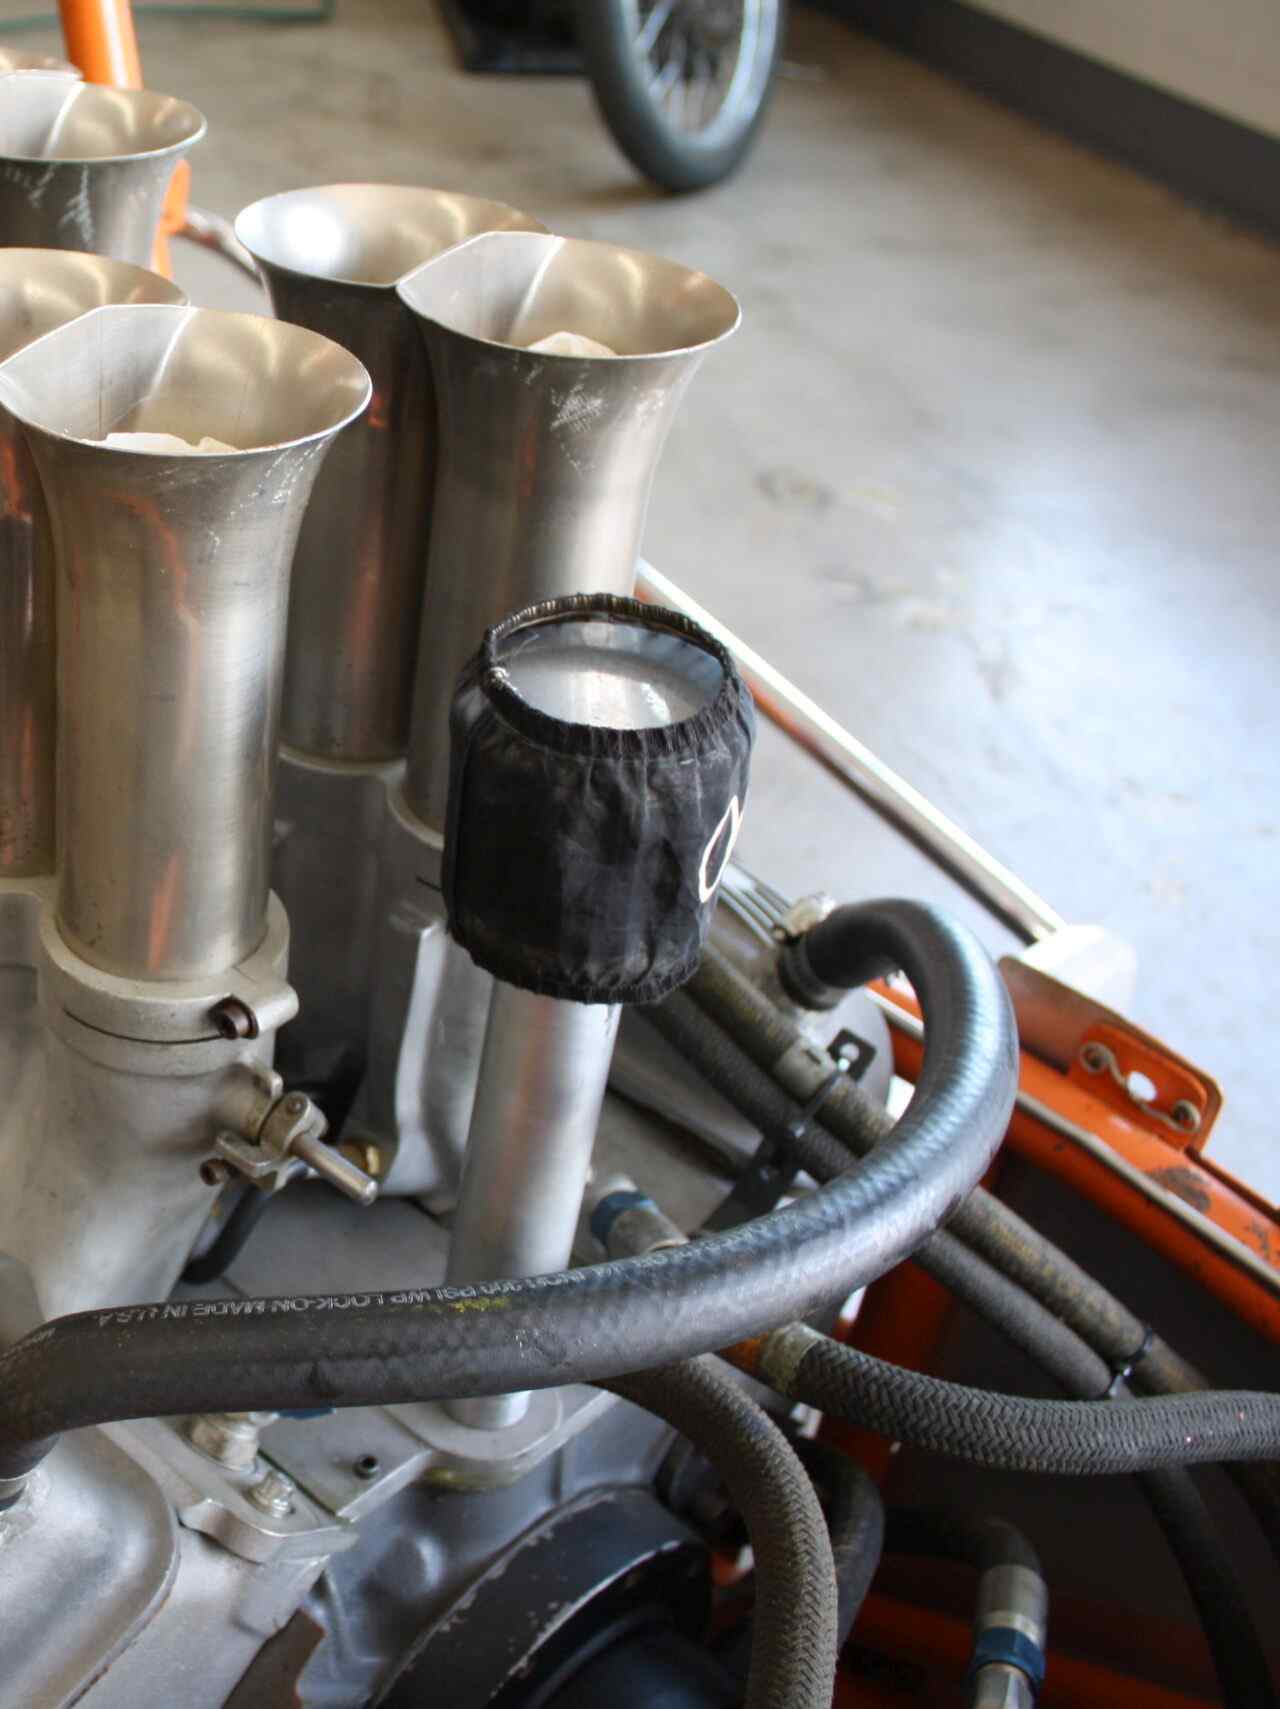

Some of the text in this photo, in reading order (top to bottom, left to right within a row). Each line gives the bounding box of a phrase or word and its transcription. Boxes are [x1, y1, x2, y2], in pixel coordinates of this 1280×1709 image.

[436, 1287, 477, 1300] PSI
[163, 1303, 188, 1318] IN
[192, 1301, 266, 1316] MADE
[271, 1295, 385, 1313] LOCK-ON
